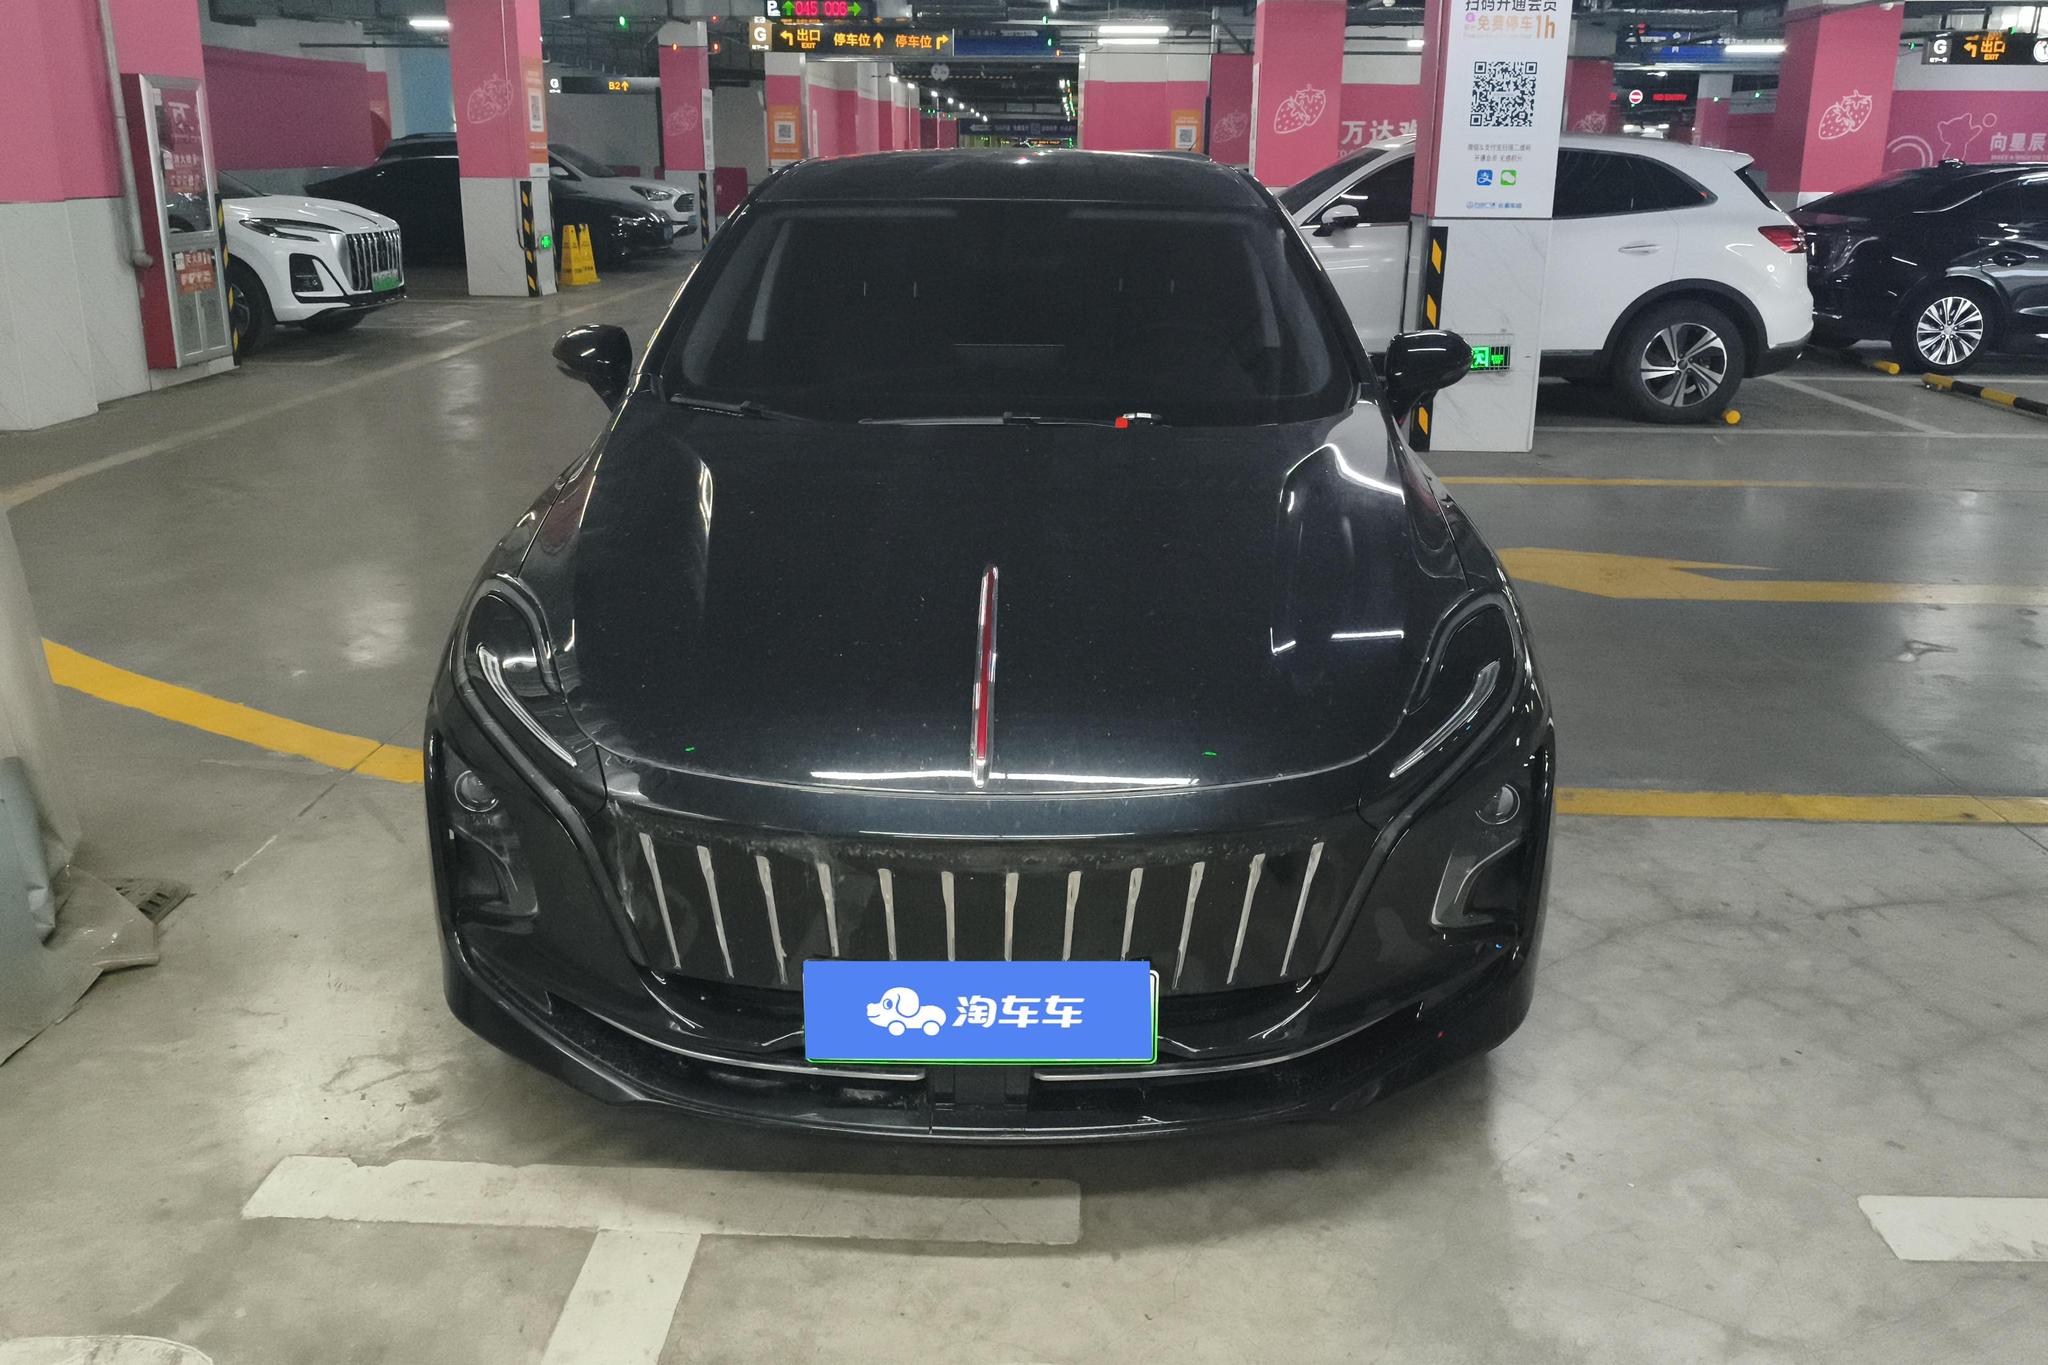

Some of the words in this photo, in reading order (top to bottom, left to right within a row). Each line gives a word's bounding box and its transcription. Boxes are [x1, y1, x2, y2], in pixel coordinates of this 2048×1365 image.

[754, 27, 767, 42] G
[1536, 15, 1555, 39] 1h
[797, 29, 821, 41] 出口
[834, 32, 871, 47] 停车位
[895, 34, 932, 48] 停车位
[1933, 39, 1947, 54] G
[1981, 41, 2005, 53] 出口
[550, 79, 559, 88] G
[608, 81, 620, 90] B2
[1990, 132, 2047, 152] 向星辰
